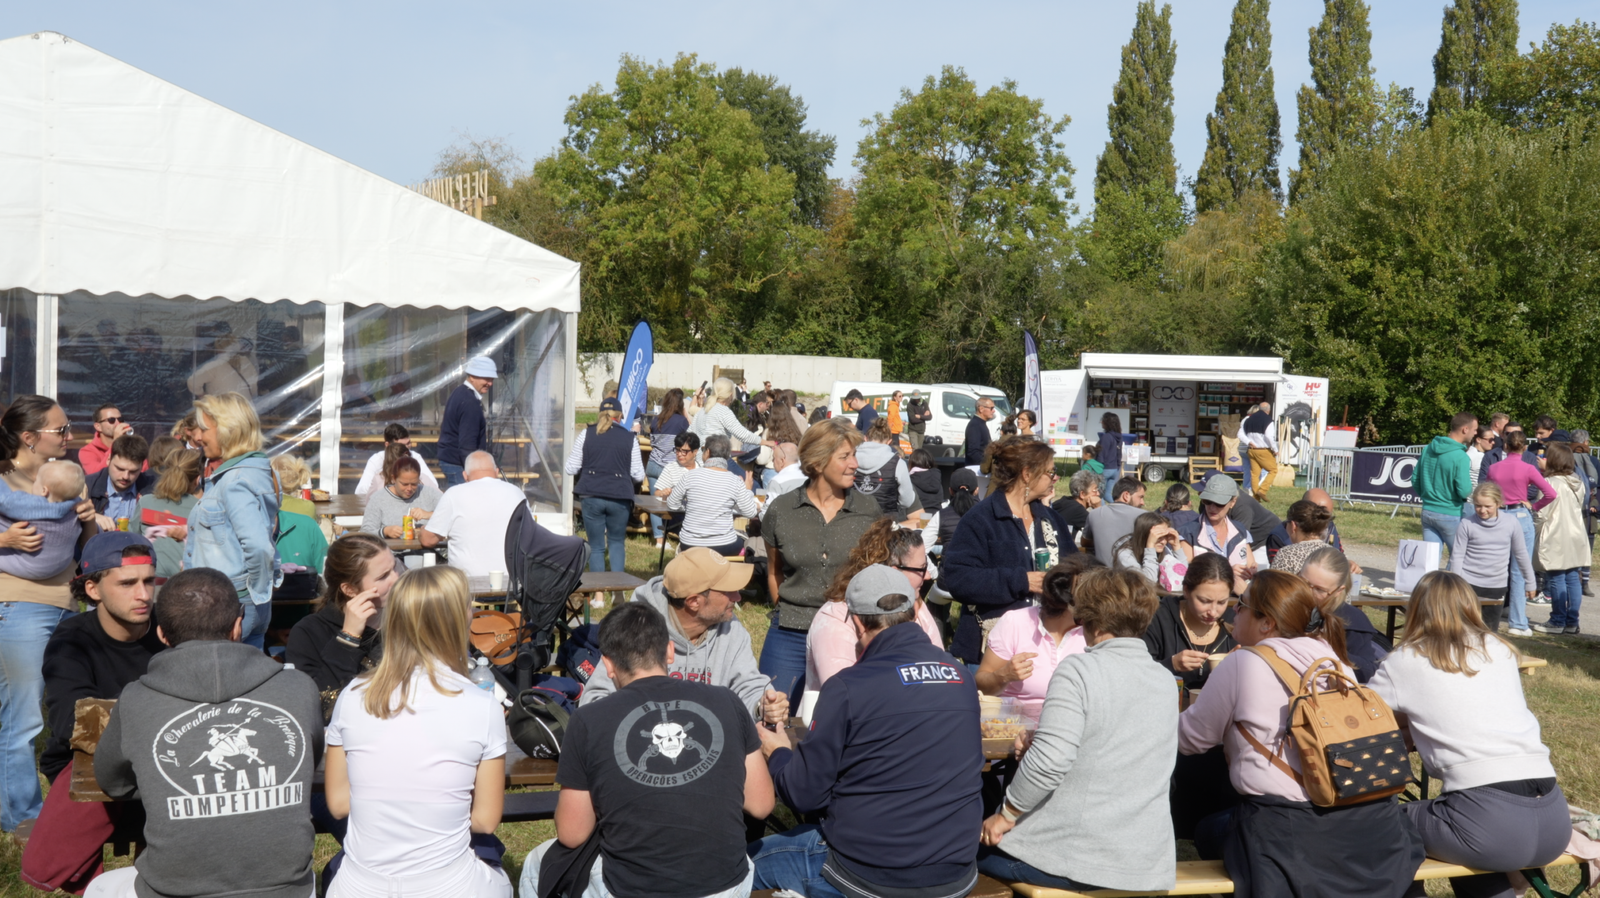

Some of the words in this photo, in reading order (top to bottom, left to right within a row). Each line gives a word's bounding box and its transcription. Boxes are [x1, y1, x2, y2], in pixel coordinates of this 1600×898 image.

[1368, 456, 1419, 488] JO
[1400, 493, 1412, 502] 69
[900, 665, 961, 682] FRANCE
[227, 703, 243, 714] de
[247, 707, 262, 718] la
[641, 700, 681, 713] BOPE
[163, 707, 221, 745] Chevalerie
[158, 749, 181, 768] La
[626, 766, 678, 785] OPERAÇÕES
[682, 748, 720, 781] ESPECIAIS
[192, 765, 277, 795] TEAM
[169, 784, 301, 818] COMPETITION
